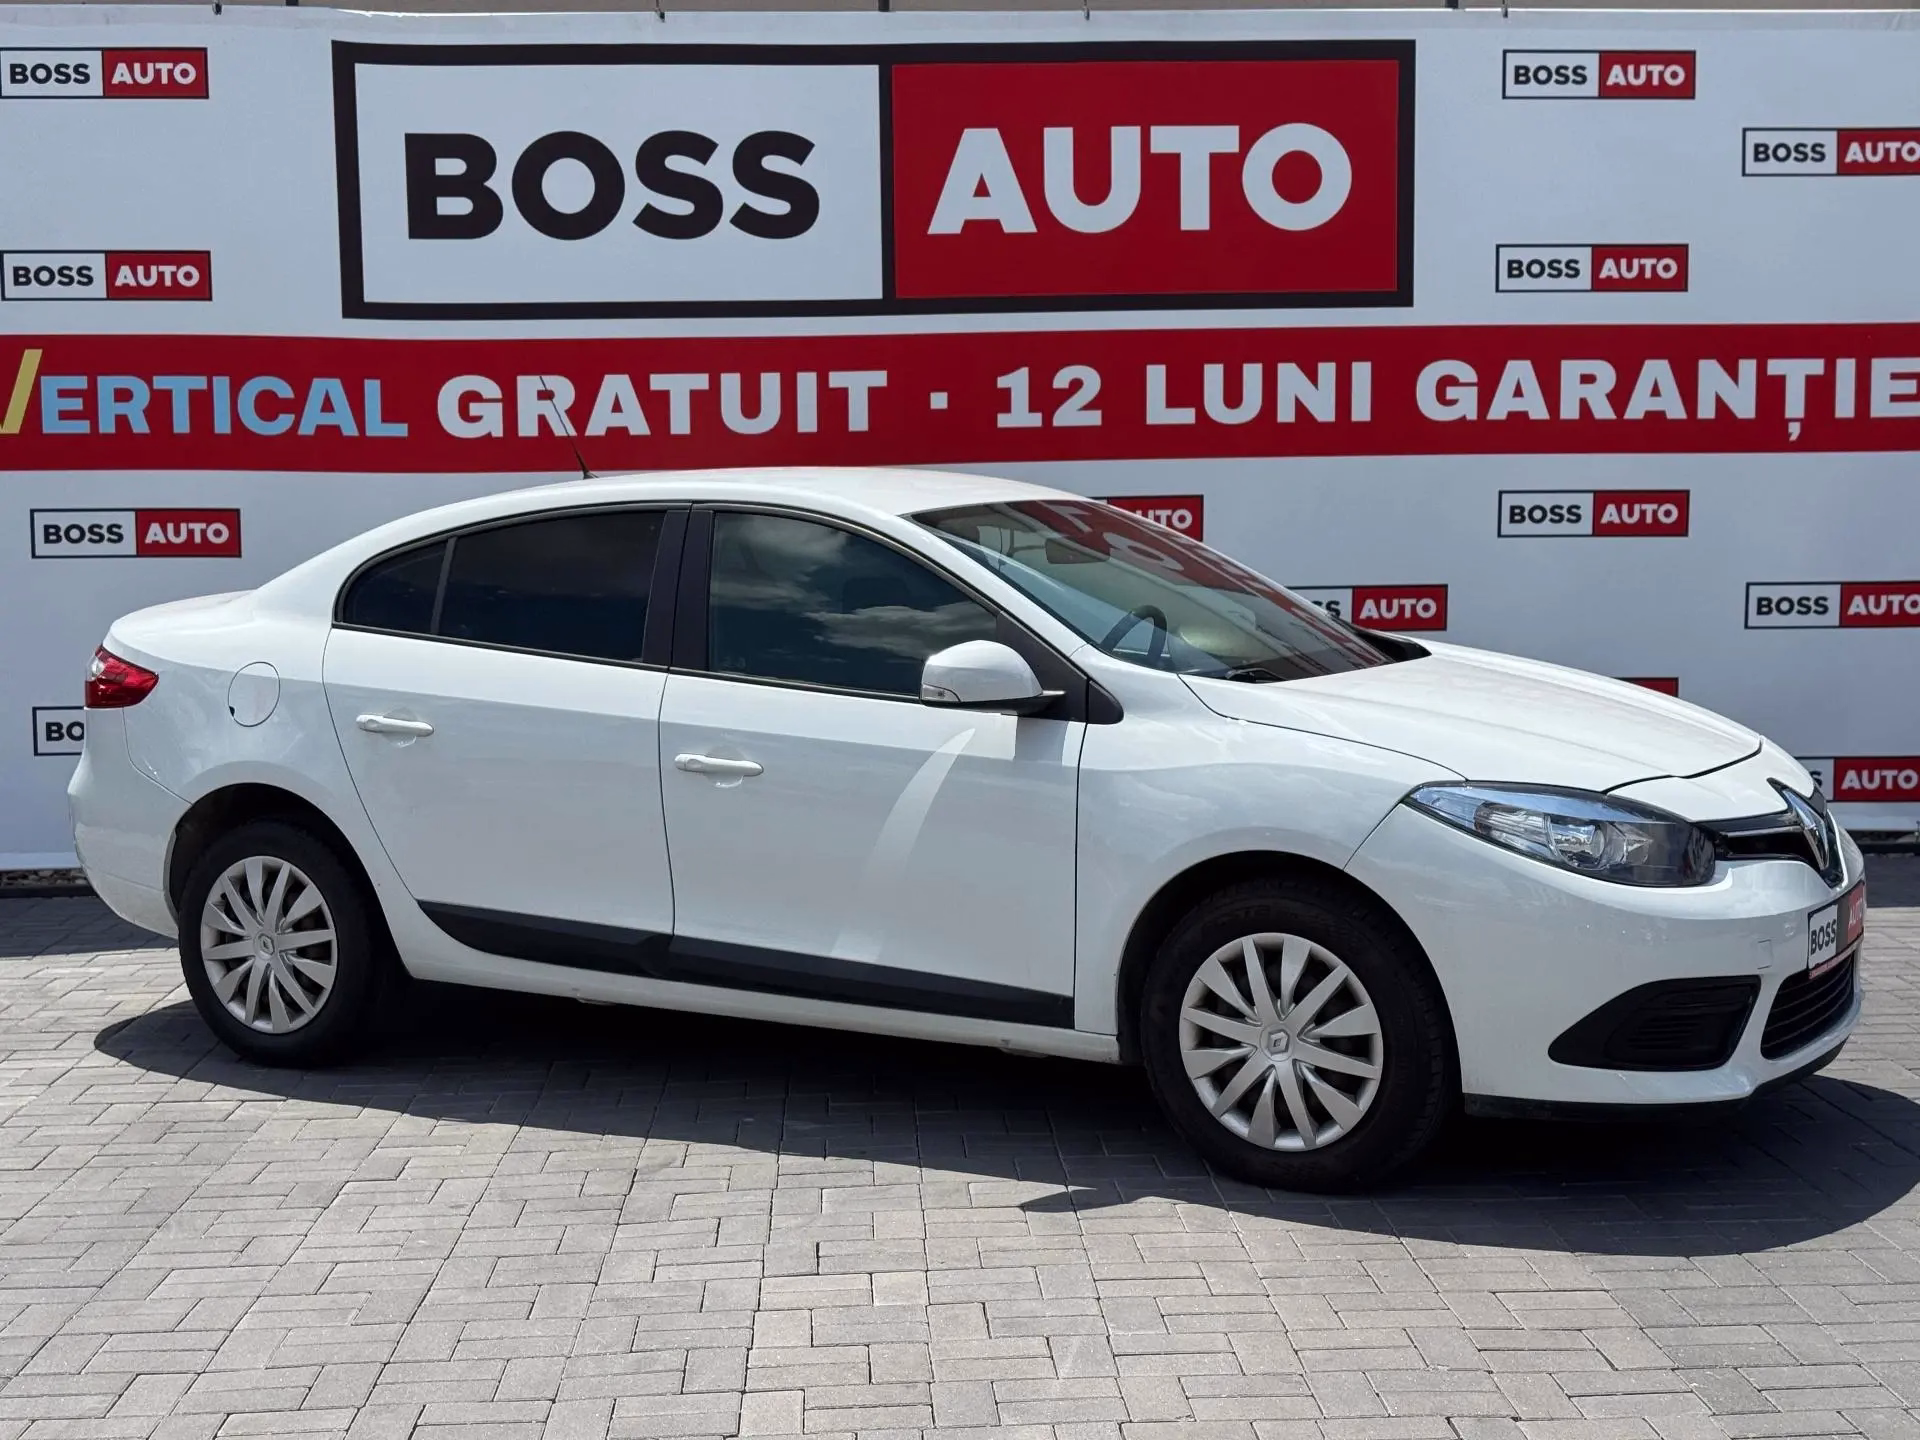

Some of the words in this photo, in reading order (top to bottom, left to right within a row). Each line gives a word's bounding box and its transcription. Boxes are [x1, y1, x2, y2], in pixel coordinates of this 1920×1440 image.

[9, 63, 91, 85] BOSS
[111, 62, 197, 85] AUTO
[1513, 64, 1588, 86] BOSS
[1606, 64, 1686, 86] AUTO
[1753, 142, 1826, 163] BOSS
[1844, 141, 1920, 163] AUTO
[404, 130, 820, 241] BOSS
[927, 122, 1353, 235] AUTO
[12, 265, 94, 287] BOSS
[114, 265, 200, 287] AUTO
[1507, 258, 1581, 279] BOSS
[1600, 257, 1678, 279] AUTO
[437, 370, 888, 439] GRATUIT
[996, 364, 1102, 428] 12
[1145, 361, 1372, 425] LUNI
[1415, 357, 1920, 441] GARANȚIE
[1508, 504, 1582, 525] BOSS
[1600, 503, 1679, 524] AUTO
[43, 523, 124, 545] BOSS
[145, 522, 230, 544] AUTO
[1359, 598, 1437, 619] AUTO
[1756, 596, 1830, 616] BOSS
[1847, 593, 1920, 616] AUTO
[1841, 769, 1919, 790] AUTO
[1810, 918, 1837, 956] BOSS
